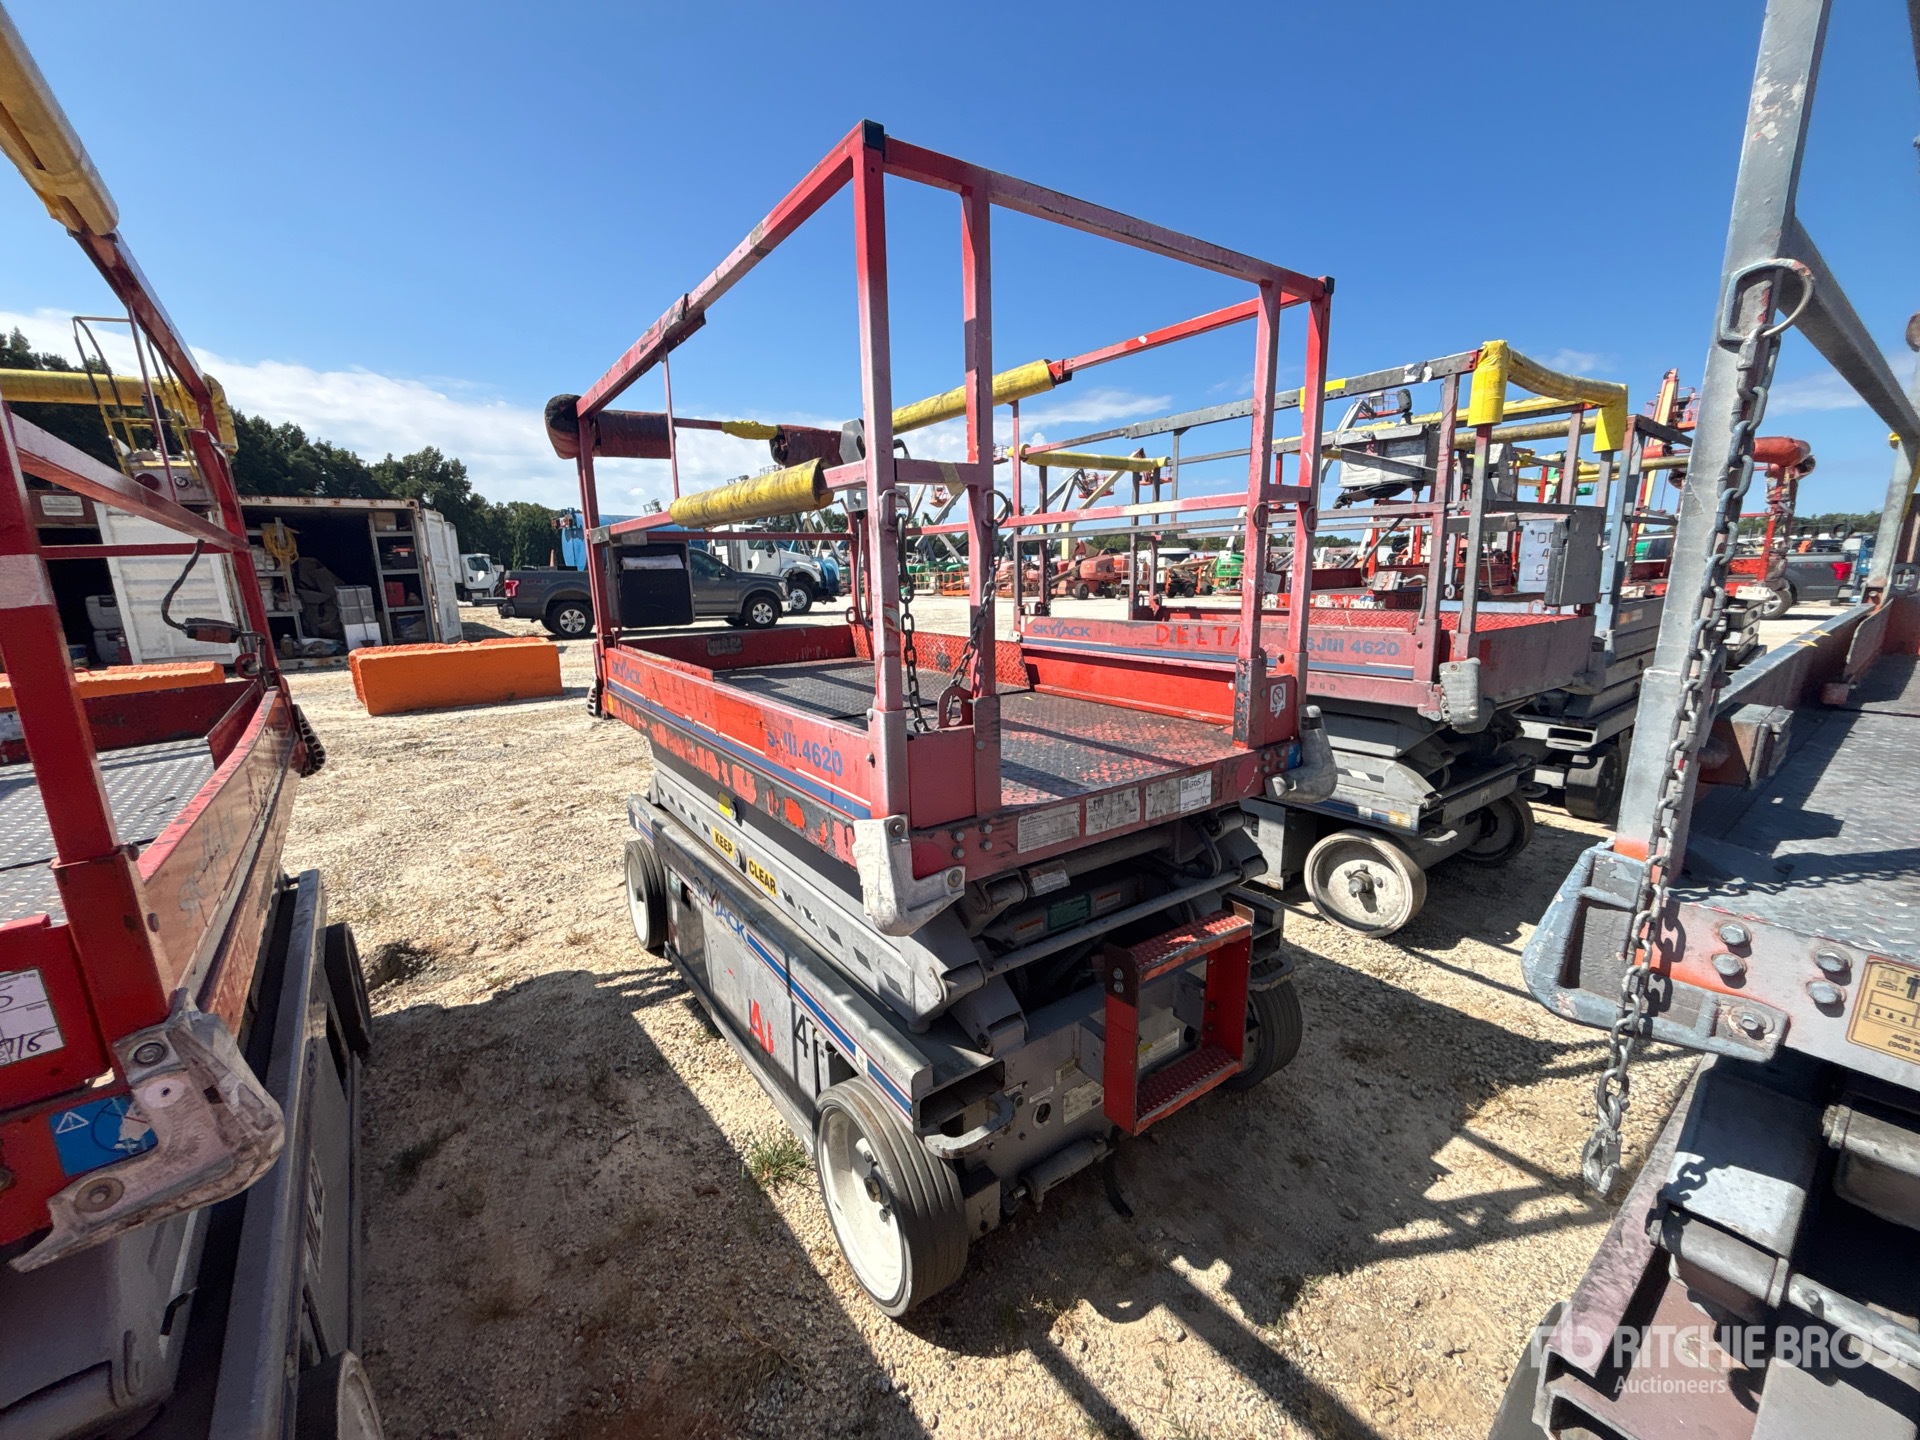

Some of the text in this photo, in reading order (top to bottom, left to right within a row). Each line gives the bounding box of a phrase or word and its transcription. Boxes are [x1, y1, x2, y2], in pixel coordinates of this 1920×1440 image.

[1032, 619, 1091, 638] SKYJACK
[1350, 640, 1399, 656] 4620
[802, 739, 843, 777] 4620
[714, 830, 777, 896] KEEP CLEAR
